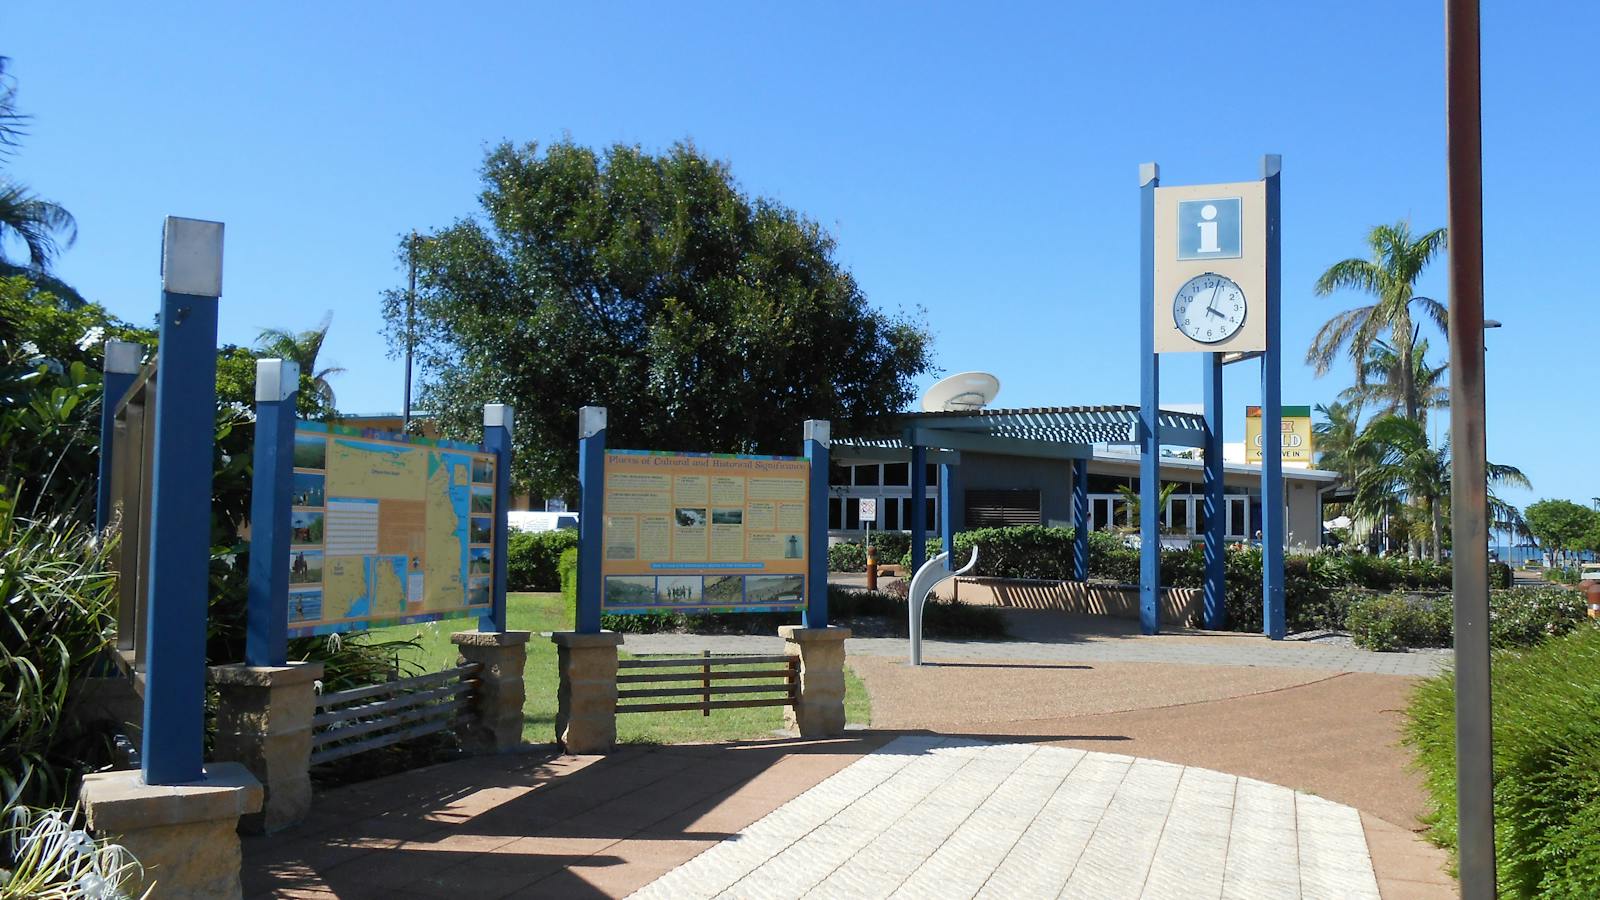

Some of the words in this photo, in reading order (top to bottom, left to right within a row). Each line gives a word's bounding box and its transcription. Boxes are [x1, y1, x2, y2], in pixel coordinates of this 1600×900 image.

[1204, 281, 1214, 289] 12
[1180, 306, 1186, 314] 9
[1206, 329, 1212, 337] 6
[1254, 434, 1302, 448] GLD
[608, 455, 639, 465] Places
[641, 456, 651, 465] of
[654, 457, 690, 467] Cultural
[692, 458, 709, 468] and
[712, 459, 753, 470] Historical
